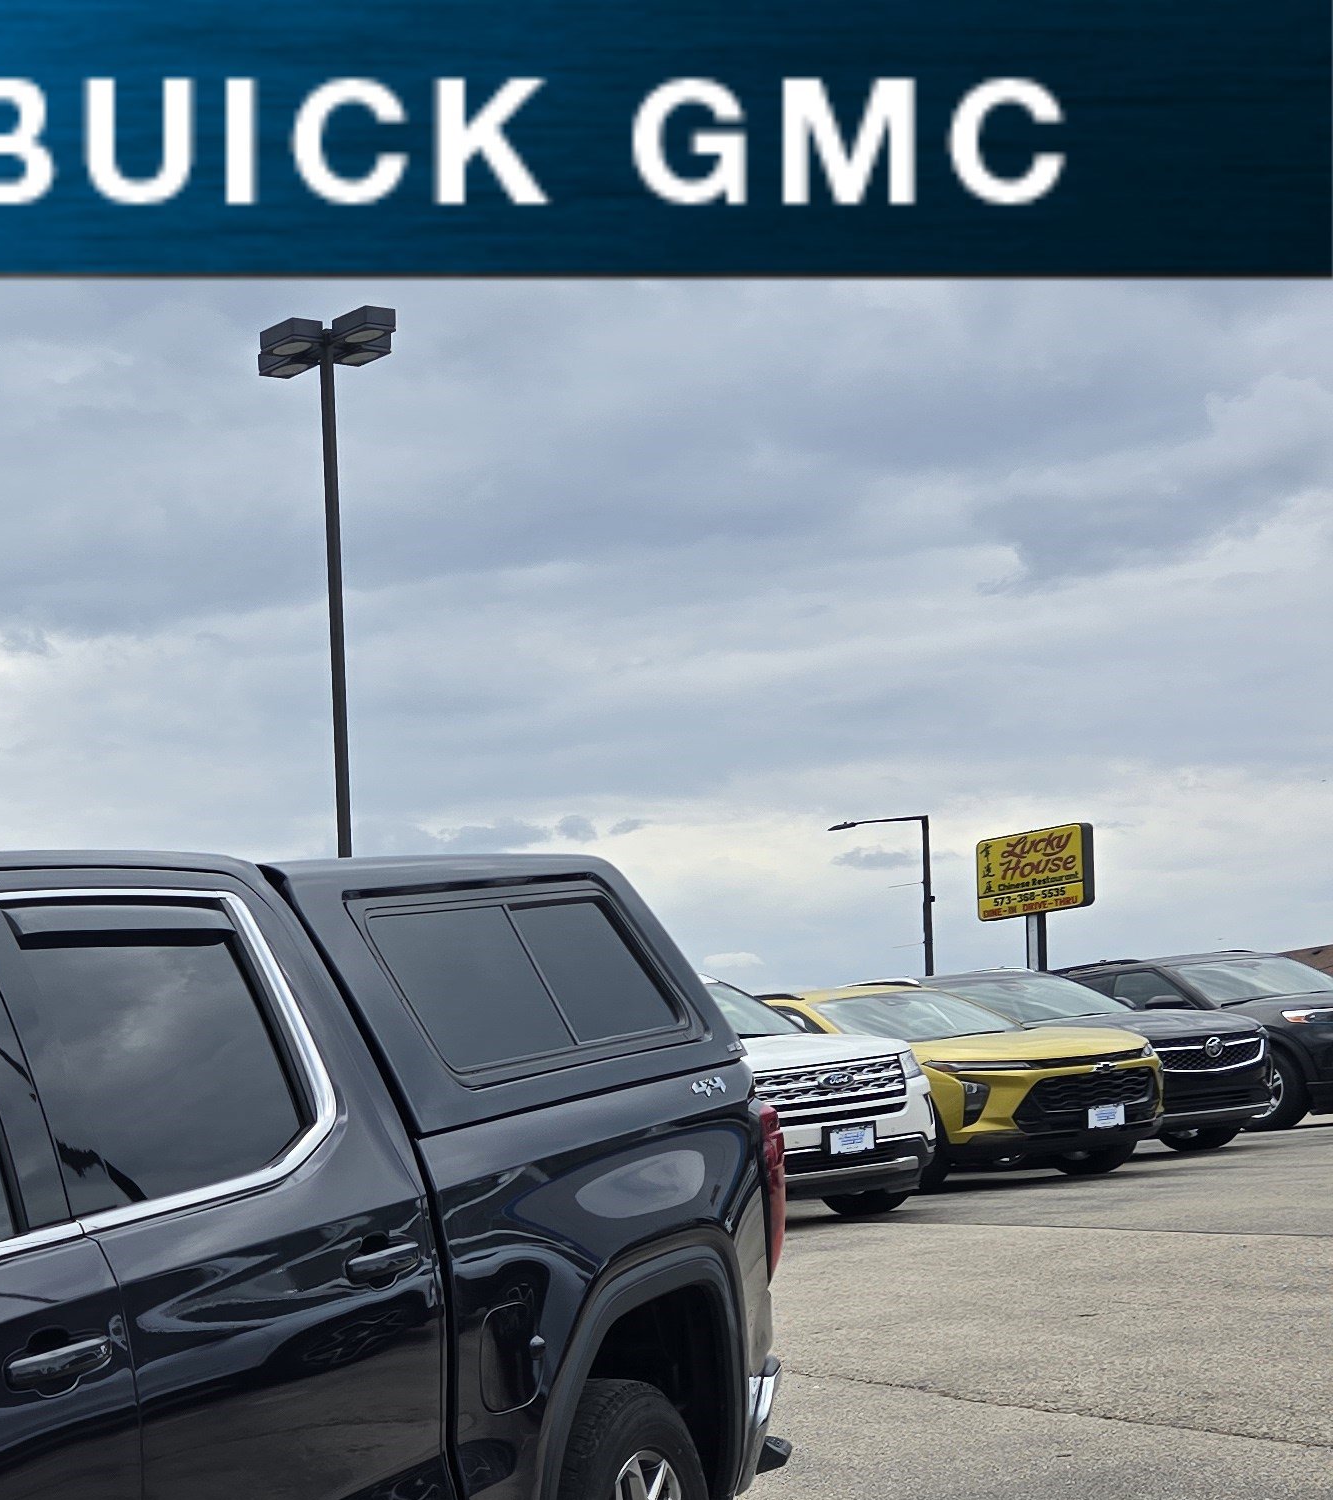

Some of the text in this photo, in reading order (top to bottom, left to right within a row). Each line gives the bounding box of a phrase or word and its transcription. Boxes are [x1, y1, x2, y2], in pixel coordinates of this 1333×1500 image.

[1001, 832, 1073, 859] Lucky
[999, 855, 1076, 880] House
[998, 871, 1079, 891] Chinese Restaurant
